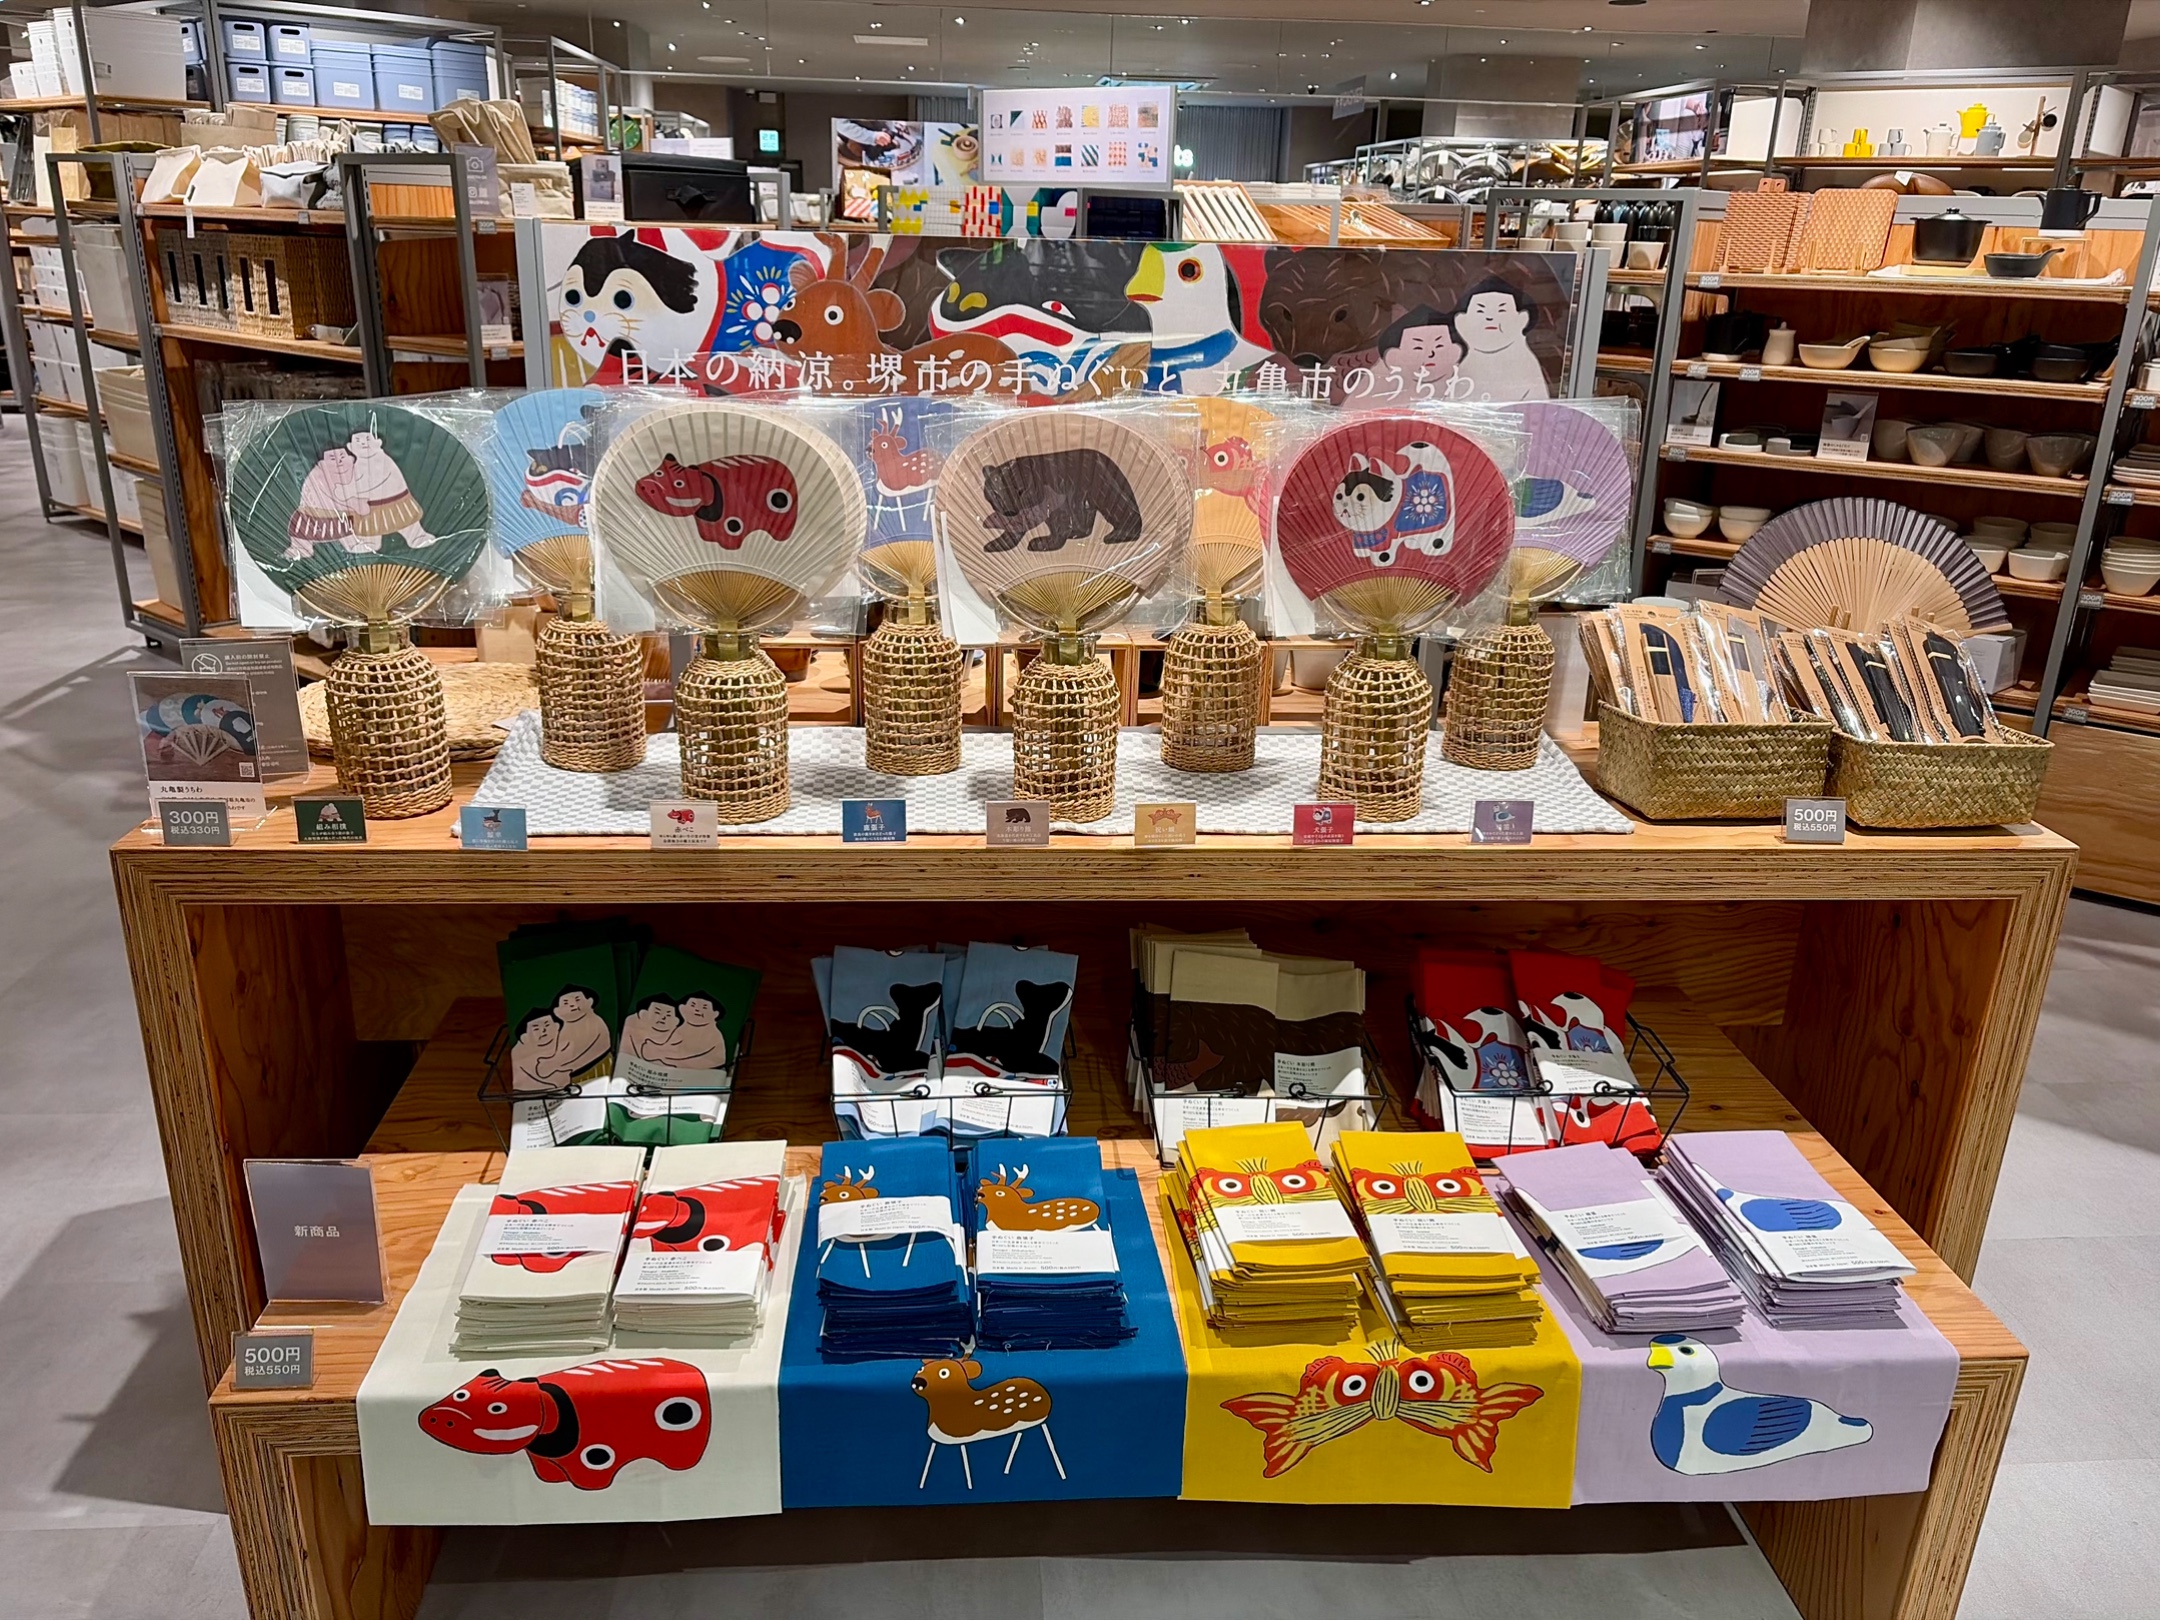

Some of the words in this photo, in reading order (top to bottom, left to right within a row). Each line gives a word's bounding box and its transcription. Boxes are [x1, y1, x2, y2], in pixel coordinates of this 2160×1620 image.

[160, 786, 203, 794] 丸亀製うちわ
[169, 810, 220, 825] 300円
[1793, 808, 1838, 823] 500円
[170, 826, 221, 836] 税込330円
[316, 823, 347, 831] 組み相撲
[1793, 822, 1837, 833] 税込550円
[294, 1224, 340, 1238] 新商品
[244, 1346, 301, 1364] 500円
[244, 1364, 301, 1377] 税込550円
